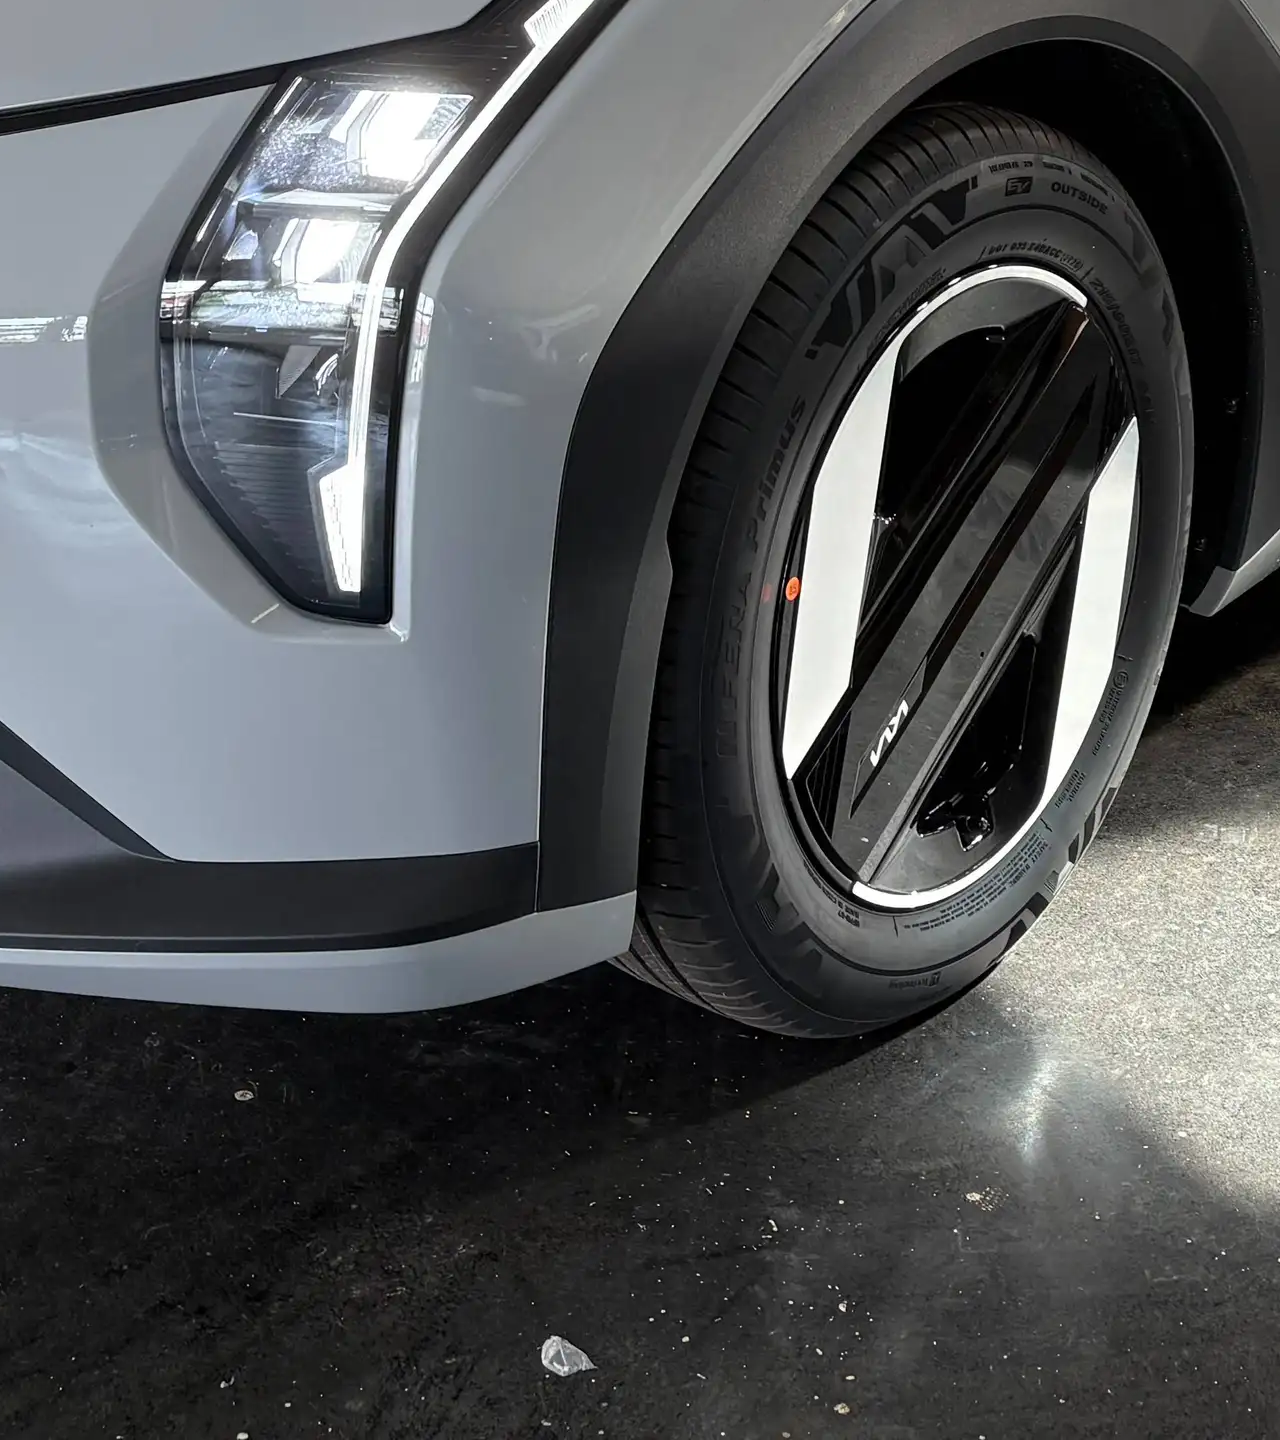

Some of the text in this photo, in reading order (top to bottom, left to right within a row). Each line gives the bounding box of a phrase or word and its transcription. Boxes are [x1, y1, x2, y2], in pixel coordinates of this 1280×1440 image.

[1051, 181, 1108, 215] OUTSIDE
[747, 392, 806, 553] Primus
[869, 699, 909, 767] KIA
